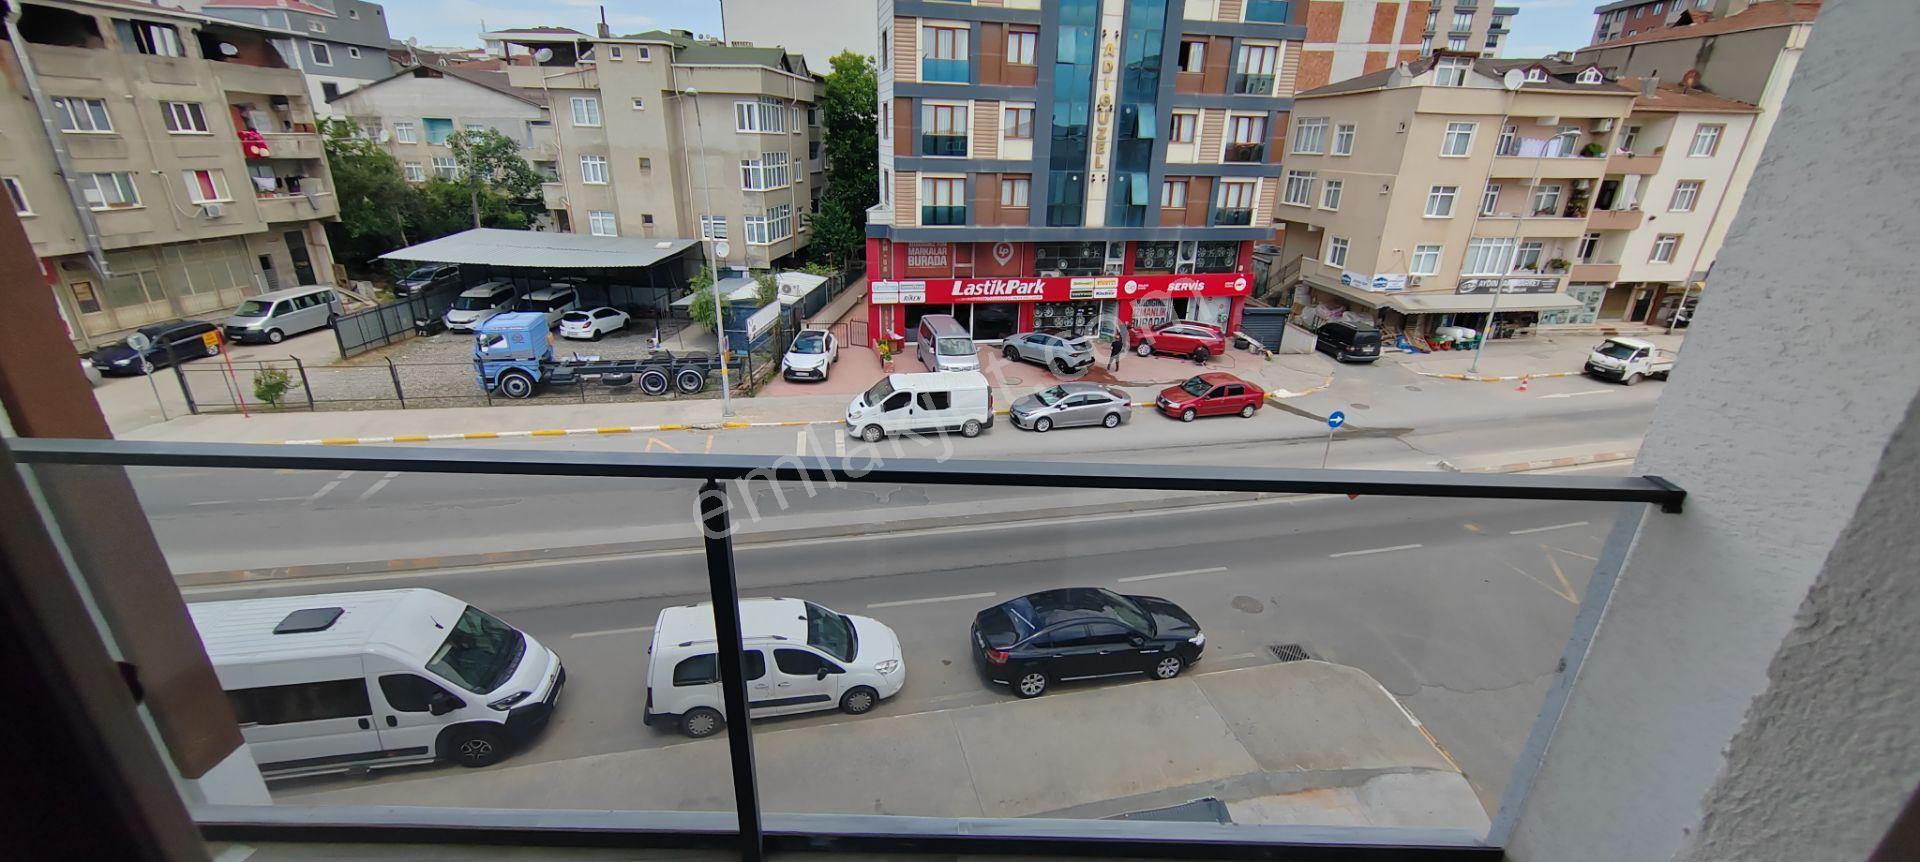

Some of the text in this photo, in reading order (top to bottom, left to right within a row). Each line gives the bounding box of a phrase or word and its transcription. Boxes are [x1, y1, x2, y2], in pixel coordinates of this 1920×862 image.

[907, 247, 948, 256] MARKALAR
[907, 255, 947, 267] BURADA
[951, 279, 1046, 296] LastikPark
[1167, 280, 1205, 291] SERVİS
